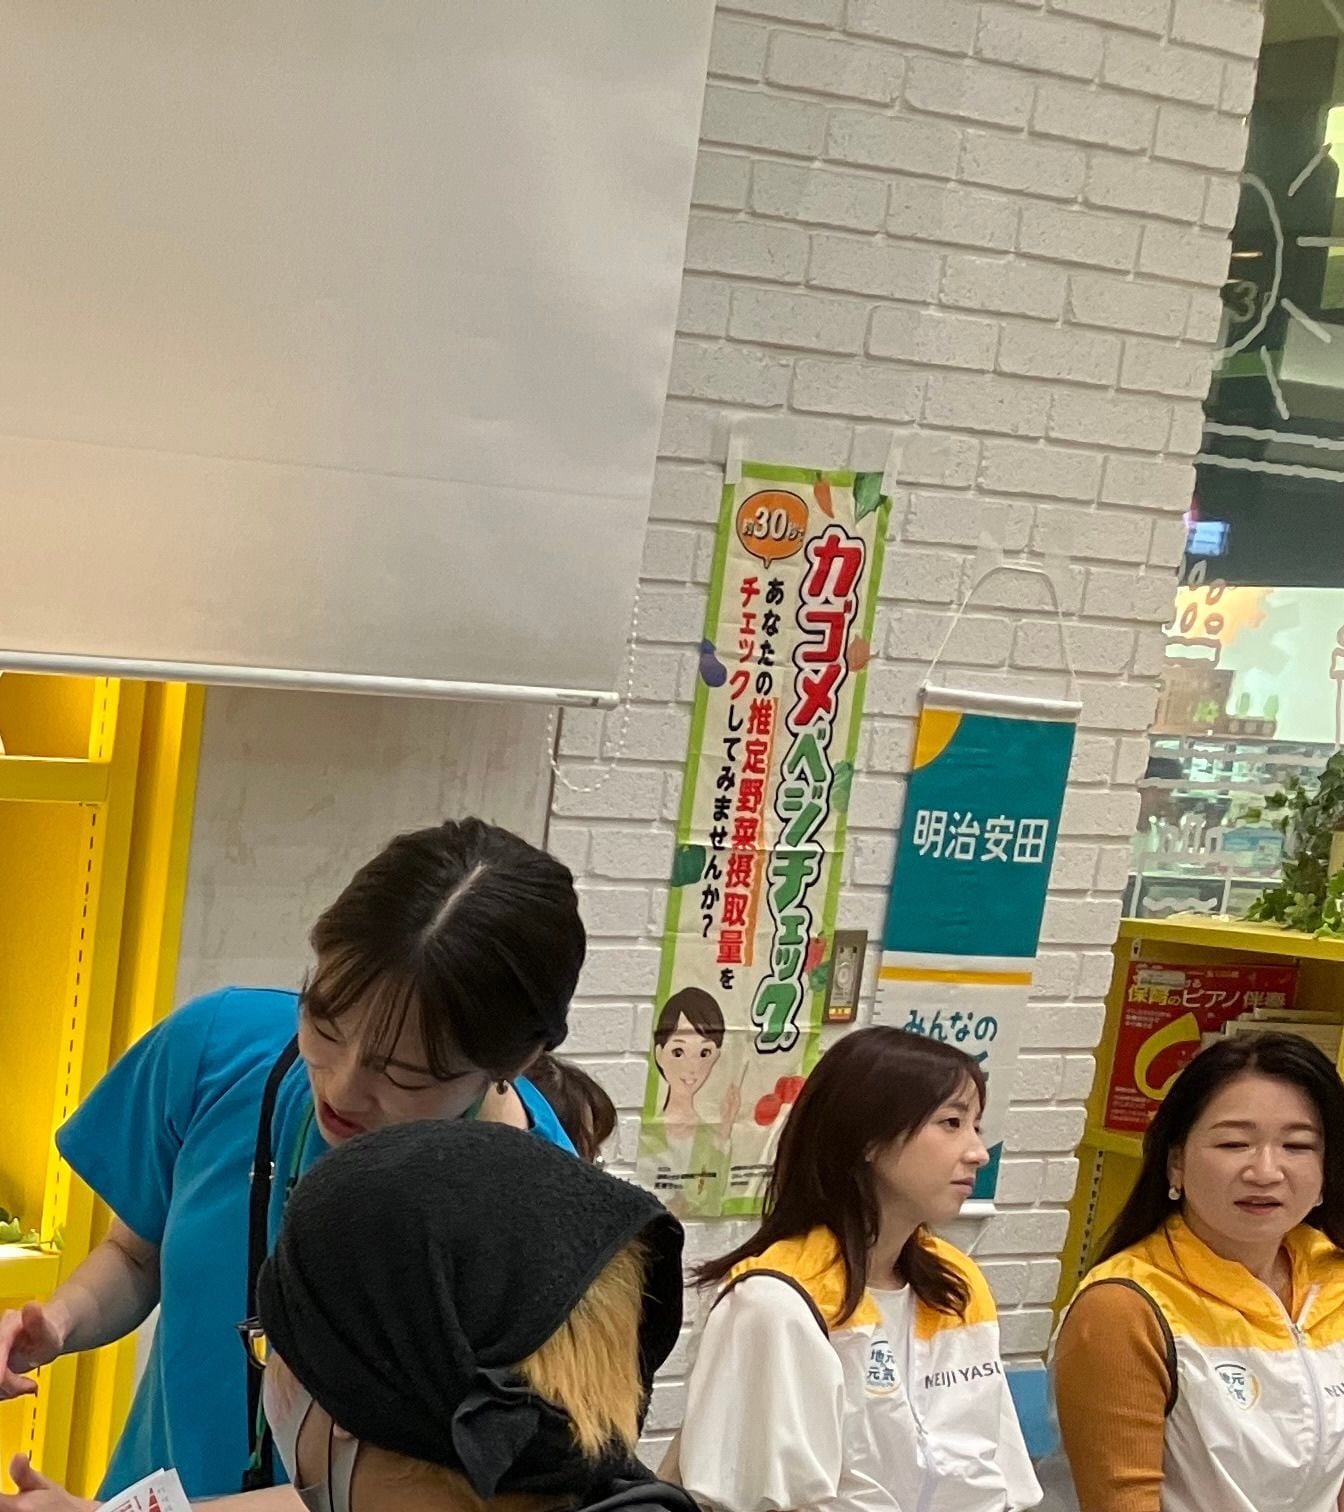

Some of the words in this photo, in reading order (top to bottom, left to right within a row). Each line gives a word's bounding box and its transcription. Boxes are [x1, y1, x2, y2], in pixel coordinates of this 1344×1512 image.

[716, 577, 785, 990] あなたの推定野菜摂取量を
[913, 809, 1049, 864] 明治安田
[904, 1010, 999, 1042] みんなの
